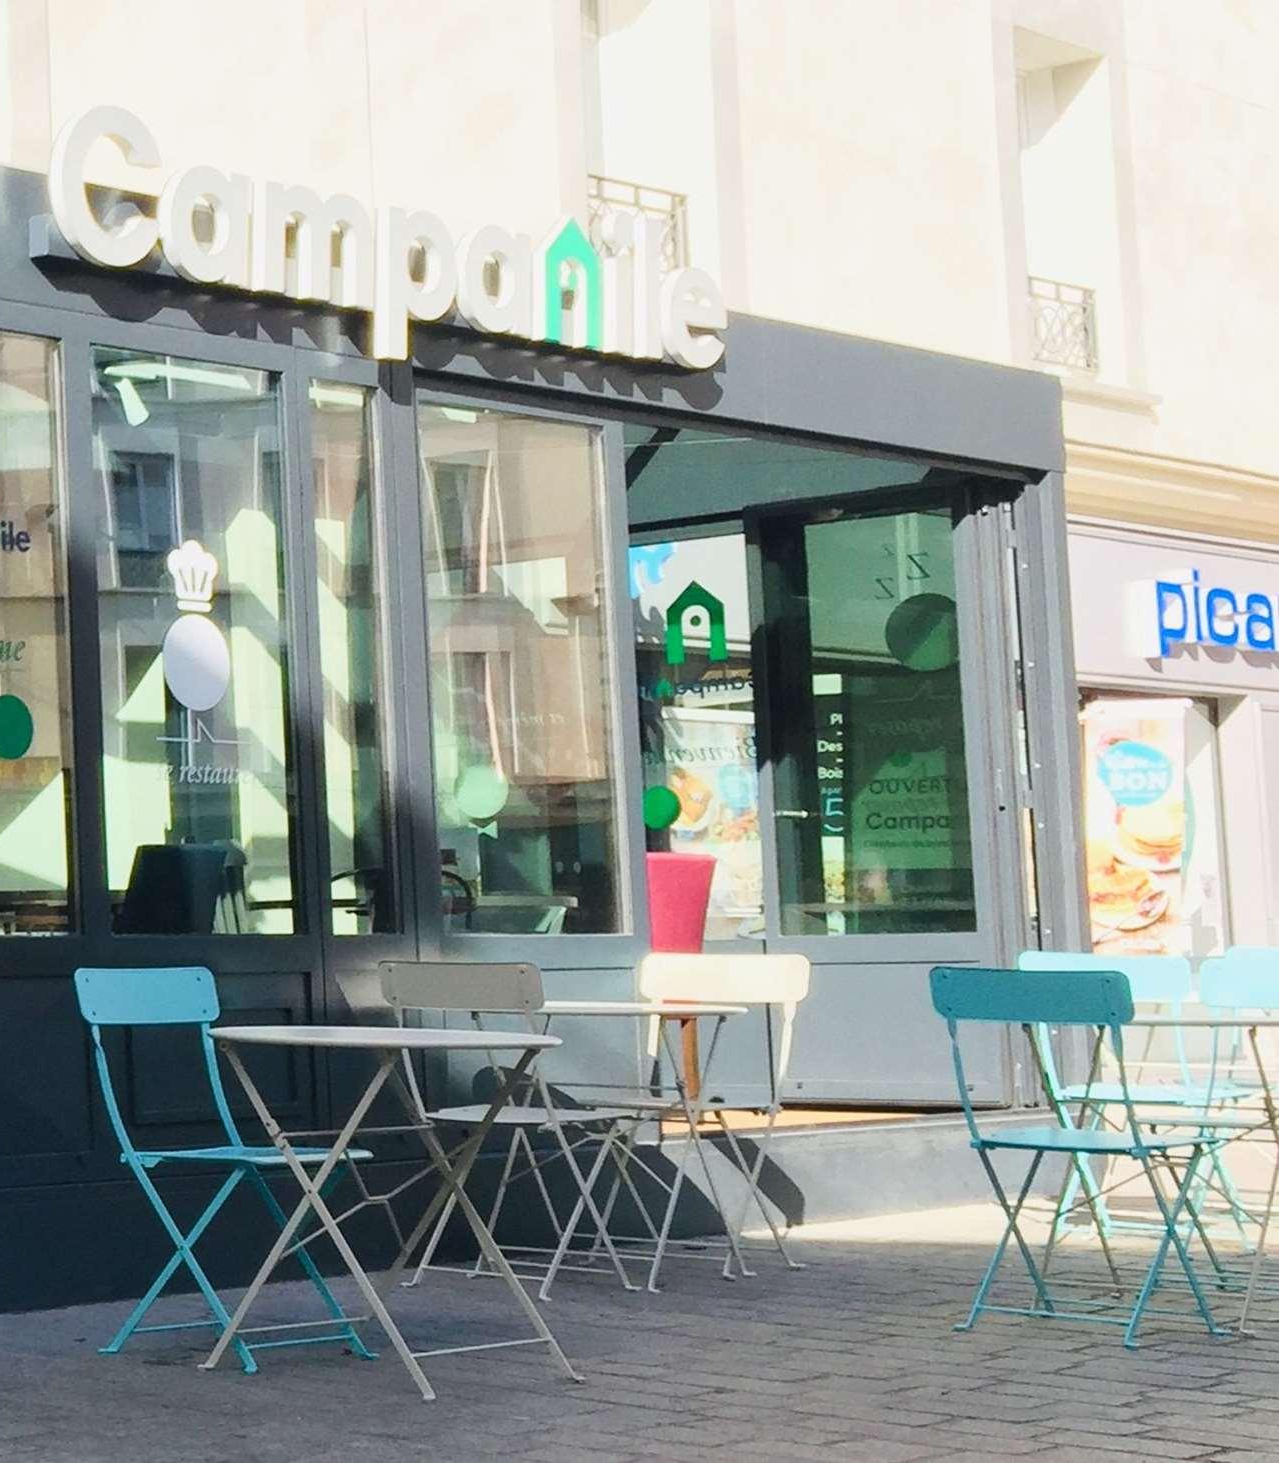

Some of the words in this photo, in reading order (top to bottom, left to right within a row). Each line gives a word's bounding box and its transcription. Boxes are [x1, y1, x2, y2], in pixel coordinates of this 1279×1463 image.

[49, 104, 728, 370] Campanile
[178, 762, 259, 786] restaur
[868, 777, 952, 796] OUVERT
